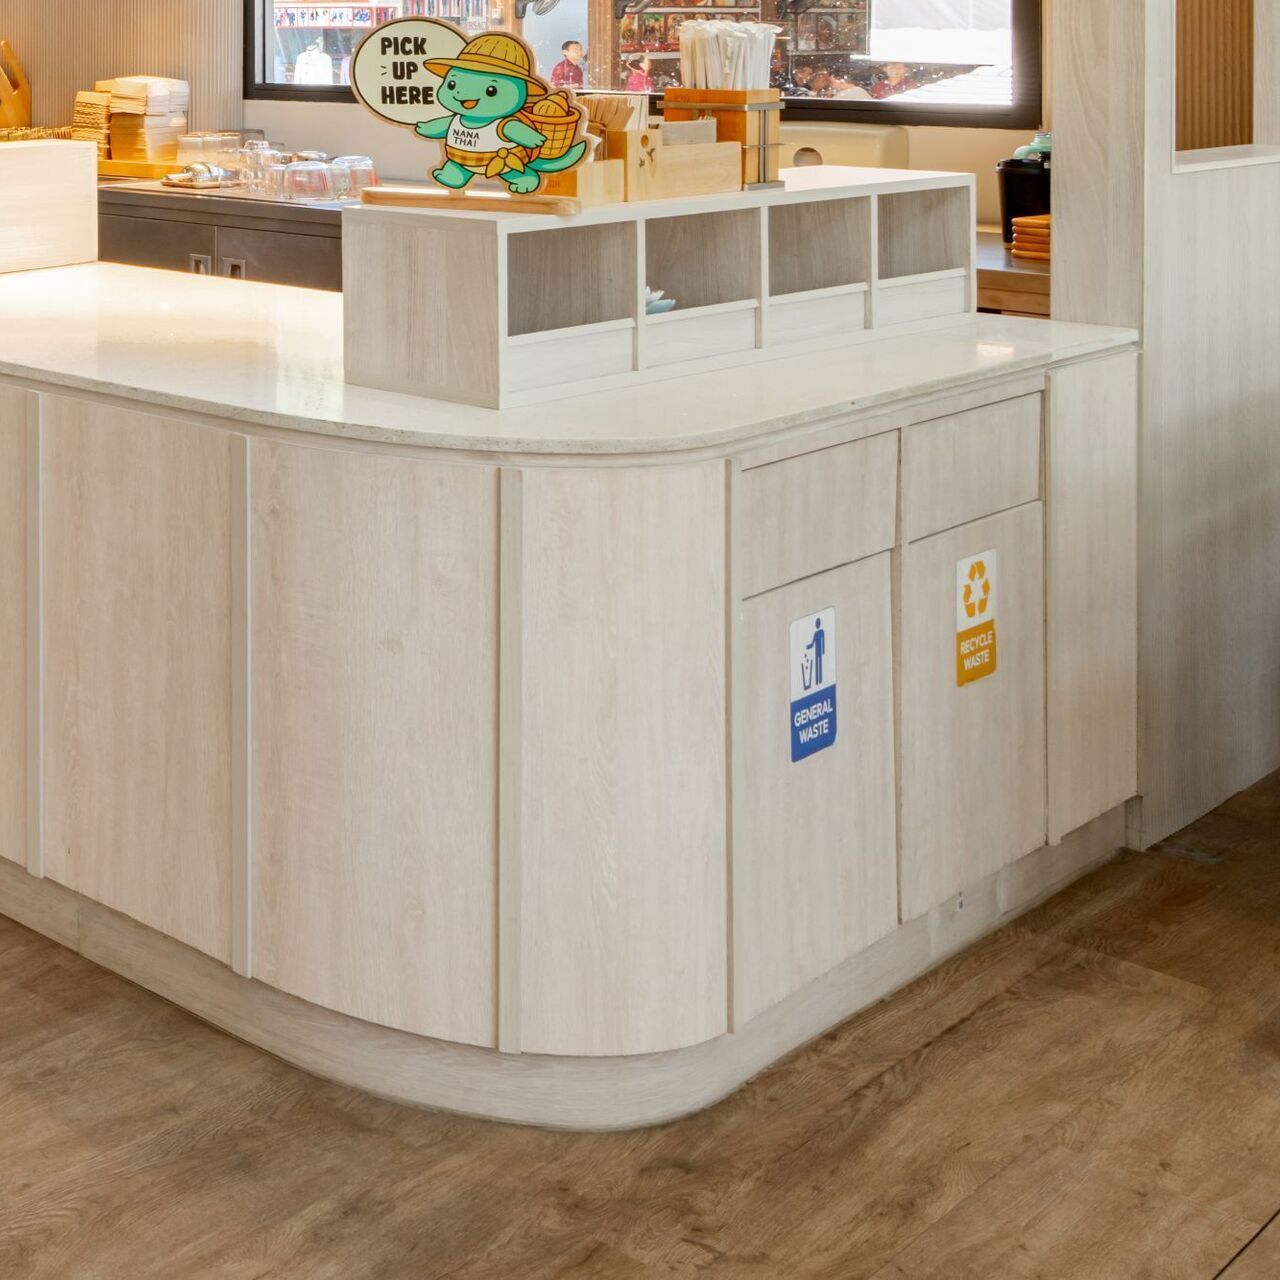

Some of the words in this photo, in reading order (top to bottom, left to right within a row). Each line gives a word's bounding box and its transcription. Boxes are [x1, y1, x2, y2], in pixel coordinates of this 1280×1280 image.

[380, 36, 427, 56] PICK
[392, 61, 419, 80] UP
[380, 86, 435, 105] HERE
[452, 128, 480, 141] NANA
[453, 136, 477, 148] THAI
[960, 630, 993, 655] RECYCLE
[963, 649, 990, 671] WASTE
[794, 698, 834, 727] GENERAL
[799, 719, 830, 744] WASTE
